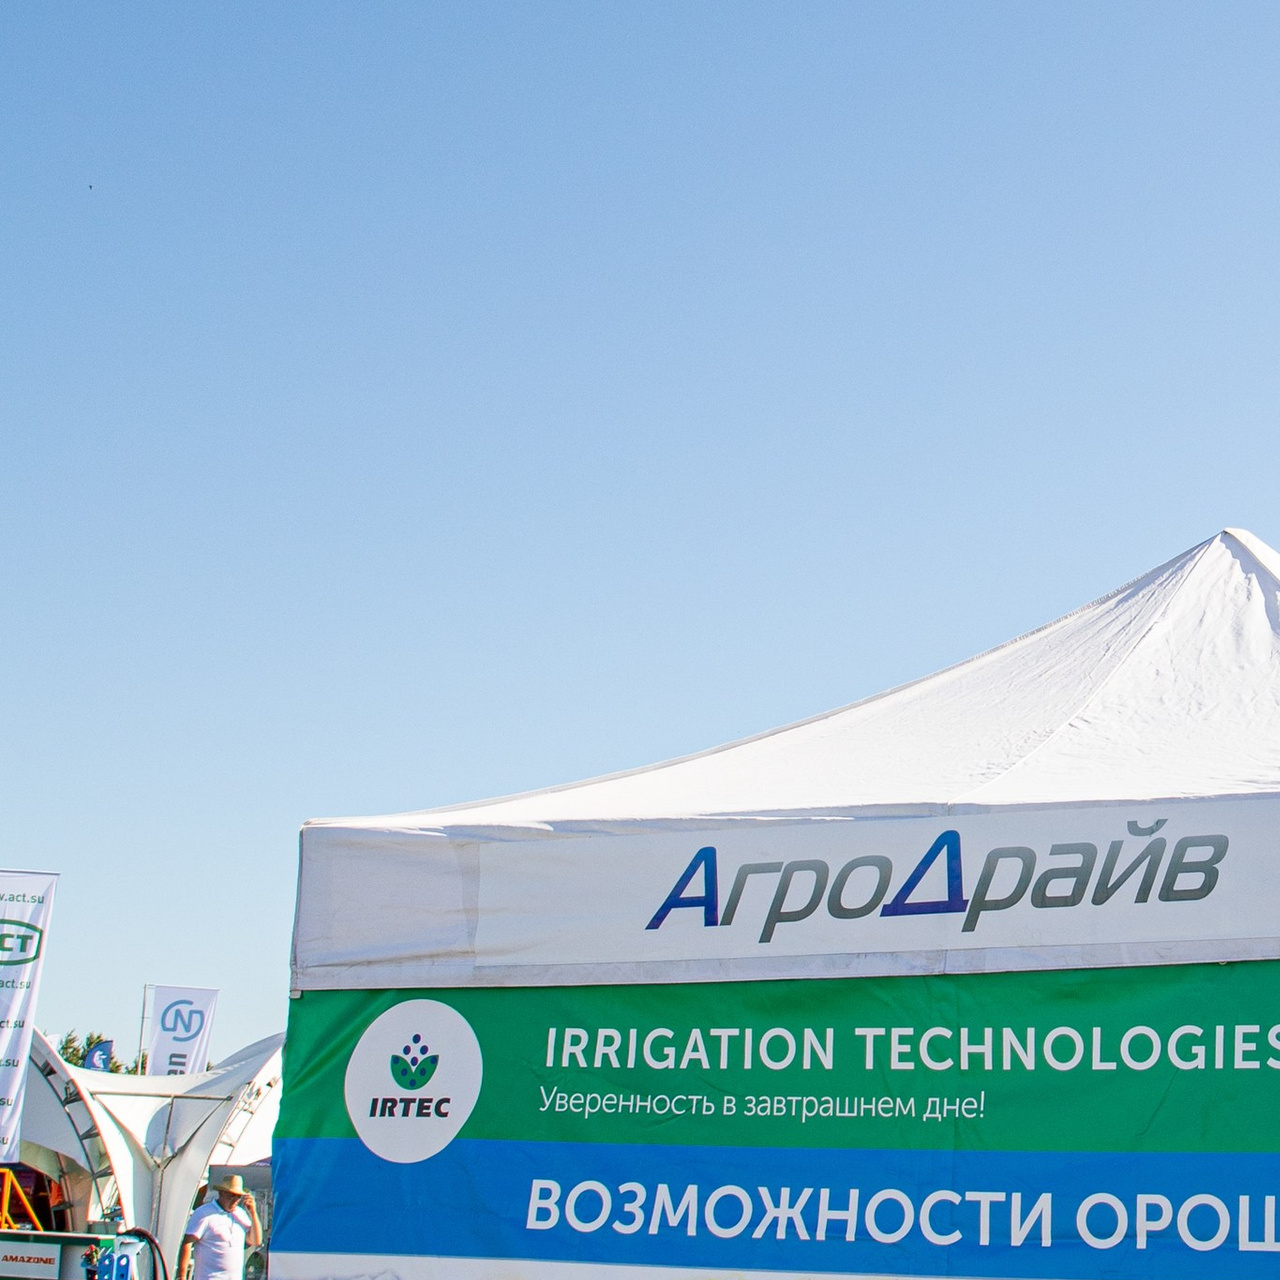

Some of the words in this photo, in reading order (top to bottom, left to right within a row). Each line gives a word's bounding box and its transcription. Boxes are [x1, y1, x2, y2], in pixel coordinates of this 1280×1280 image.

[645, 818, 1229, 943] АгроДрайв
[545, 1027, 834, 1071] IRRIGATION
[368, 1095, 451, 1119] IRTEC
[539, 1086, 715, 1119] Уверенность
[722, 1095, 736, 1116] в
[743, 1095, 916, 1123] завтрашнем
[922, 1090, 985, 1122] дне!
[525, 1179, 1052, 1247] ВОЗМОЖНОСТИ
[2, 1254, 56, 1266] AMAZONE
